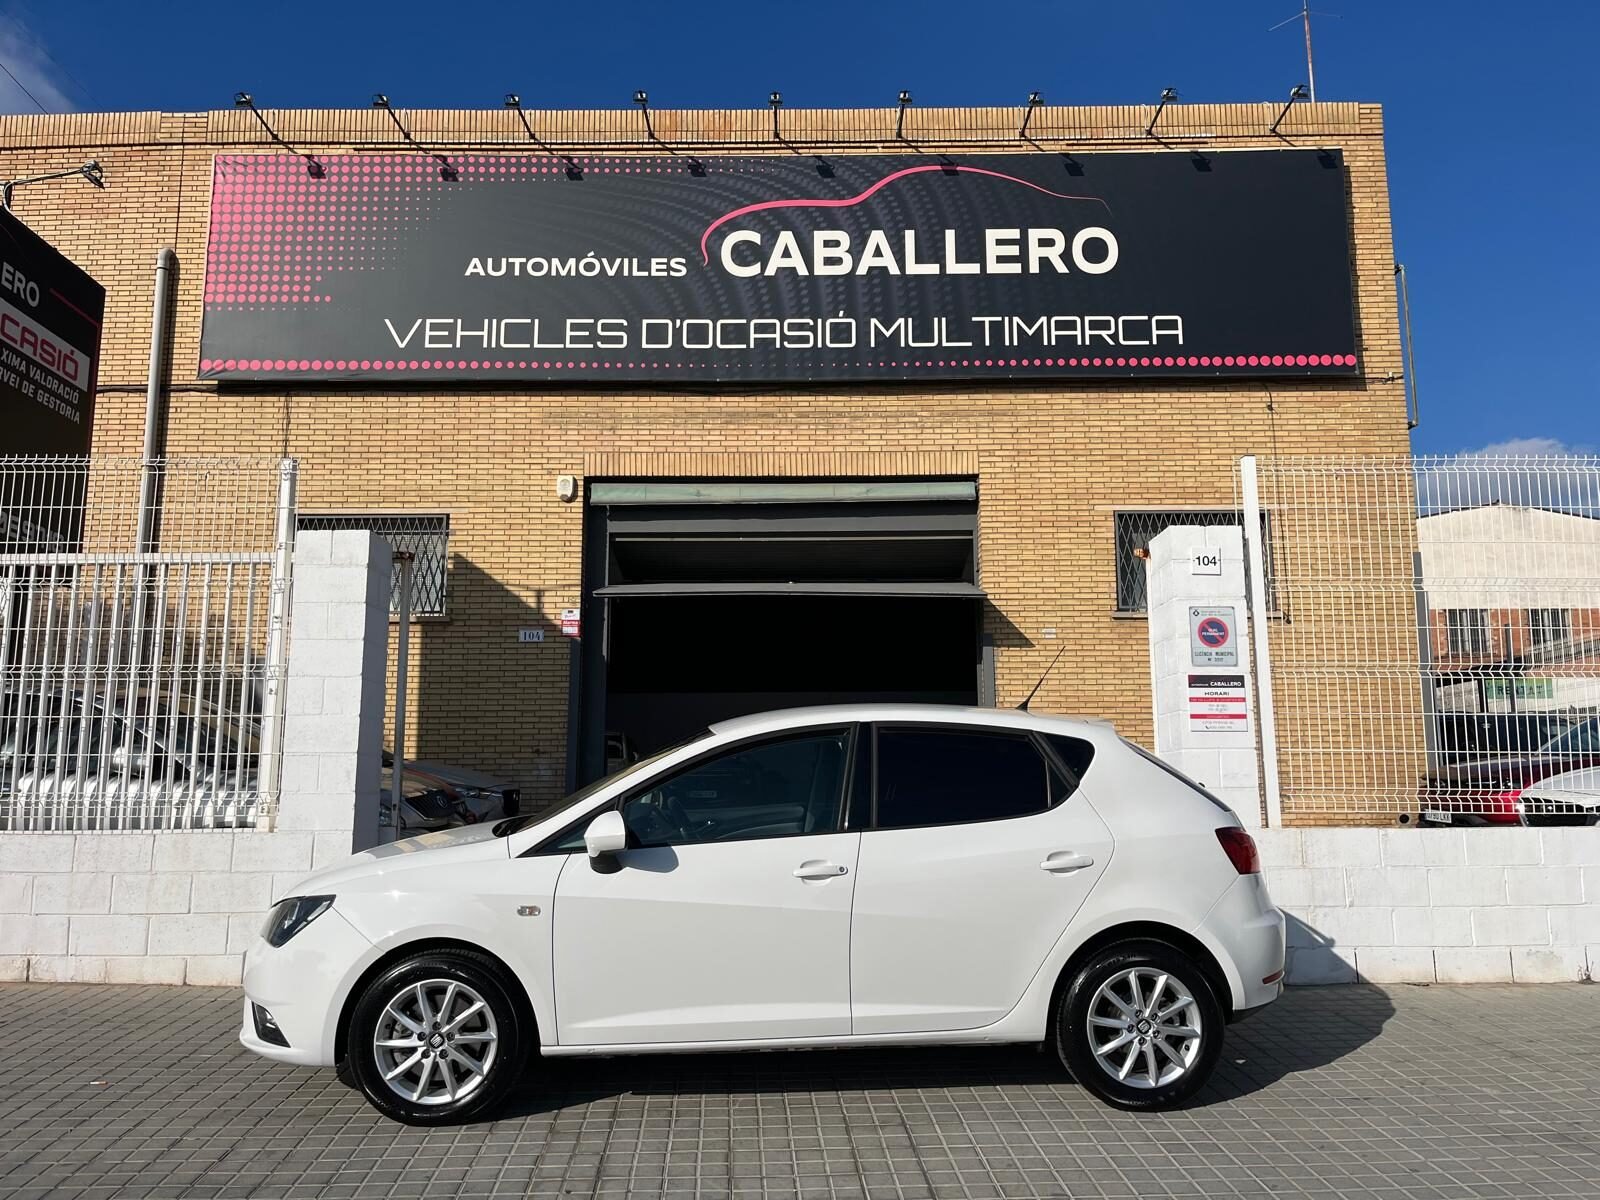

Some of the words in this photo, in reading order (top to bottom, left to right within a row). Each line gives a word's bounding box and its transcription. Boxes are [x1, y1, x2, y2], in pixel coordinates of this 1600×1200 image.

[464, 250, 688, 278] AUTOMÓVILES
[720, 226, 1120, 278] CABALLERO
[383, 317, 629, 350] VEHICLES
[640, 310, 858, 350] D'OCASIÓ
[869, 314, 1185, 349] MULTIMARCA
[21, 380, 36, 398] DE
[37, 389, 80, 425] GESTORIA
[29, 364, 80, 405] VALORACIÓ
[1195, 555, 1217, 566] 104
[524, 632, 540, 640] 104
